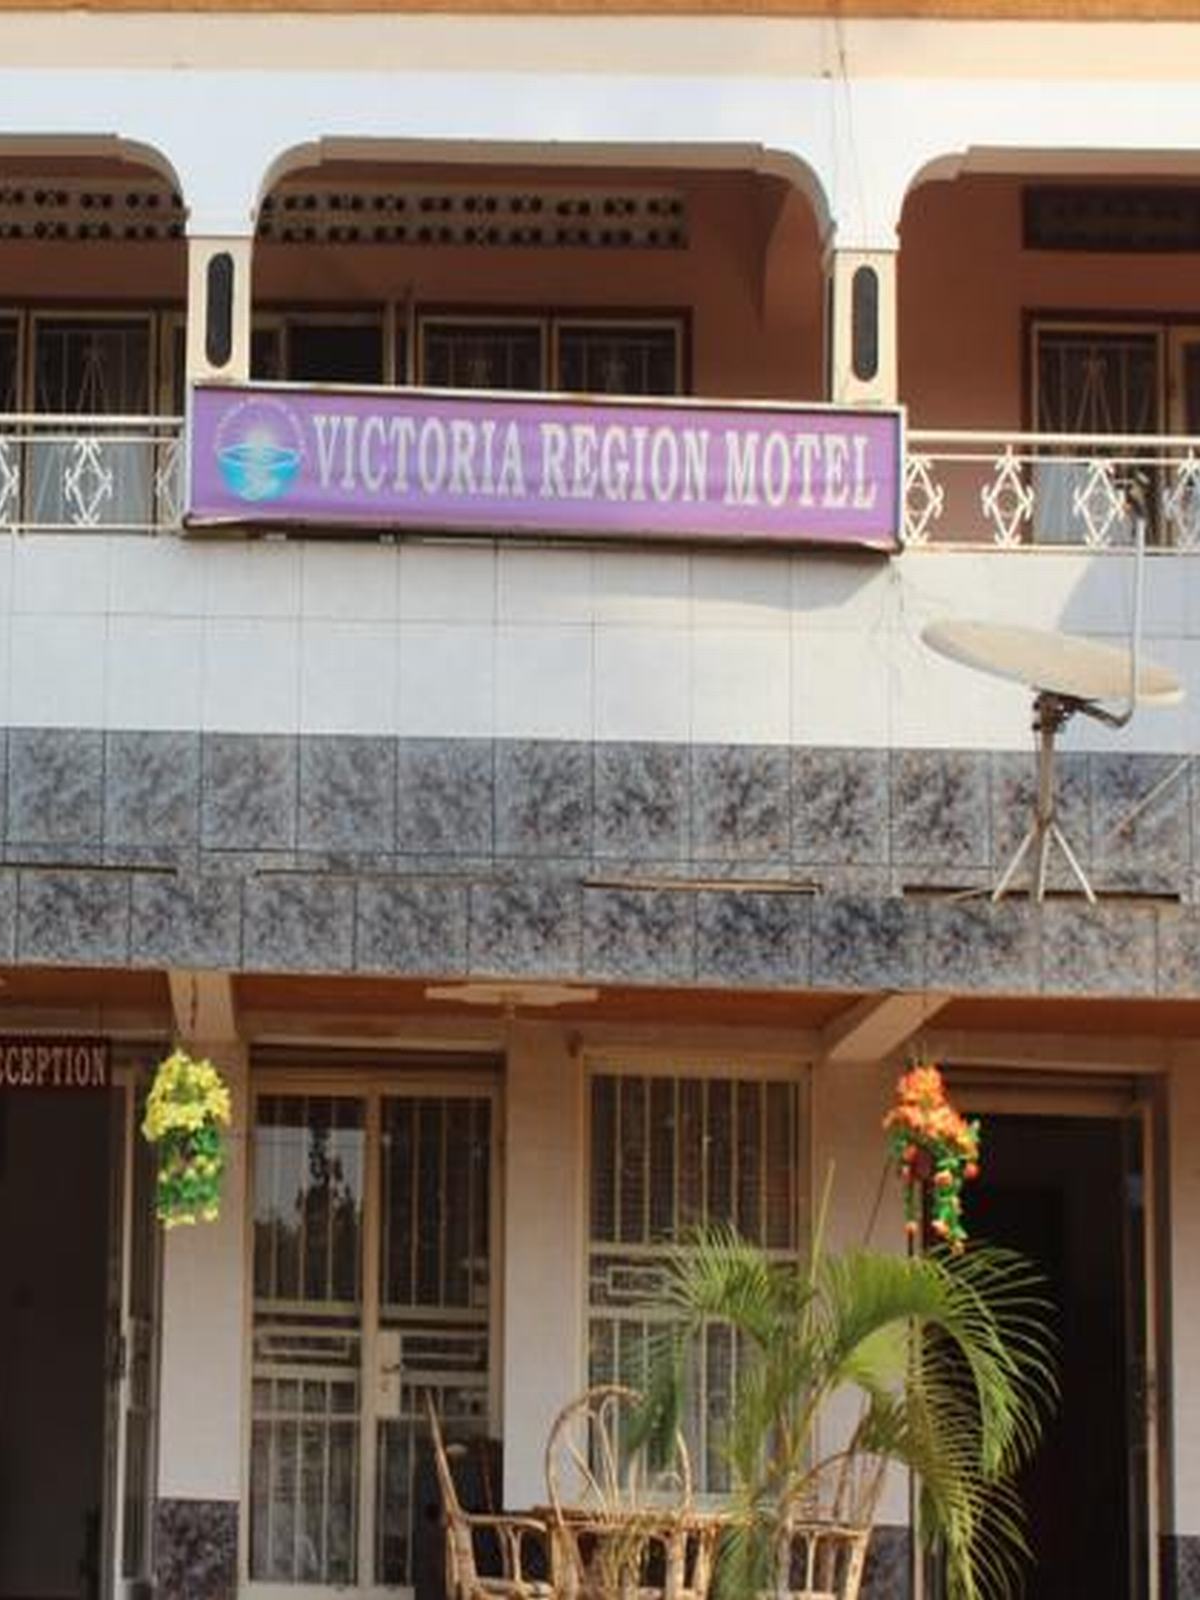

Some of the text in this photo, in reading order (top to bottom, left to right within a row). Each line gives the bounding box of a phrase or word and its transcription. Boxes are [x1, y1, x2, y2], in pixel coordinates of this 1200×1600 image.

[312, 413, 878, 511] VICTORIA REGION MOTEL
